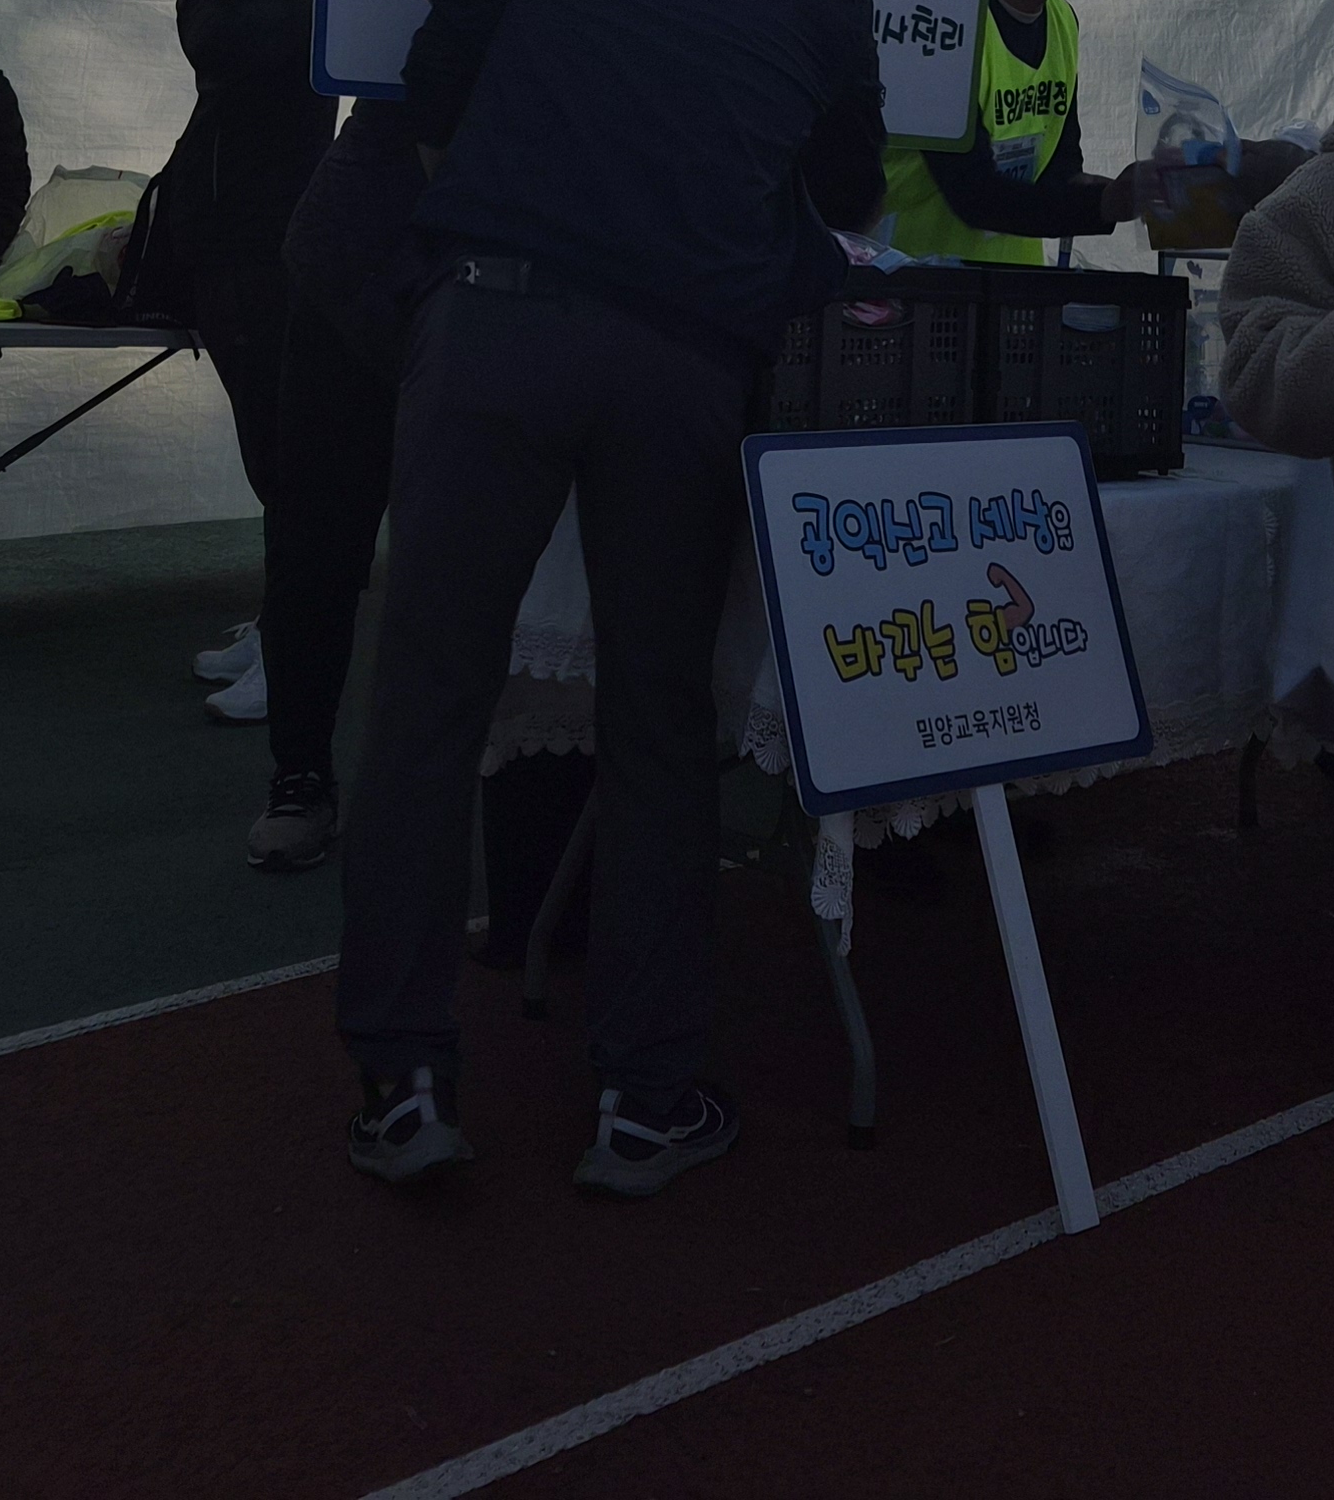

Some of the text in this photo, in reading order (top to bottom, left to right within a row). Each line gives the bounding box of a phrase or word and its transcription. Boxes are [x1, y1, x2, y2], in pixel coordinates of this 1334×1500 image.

[793, 489, 1073, 575] 공익신고 세상을
[824, 600, 957, 682] 바꾸는
[916, 702, 1042, 749] 밀양교육지원청
